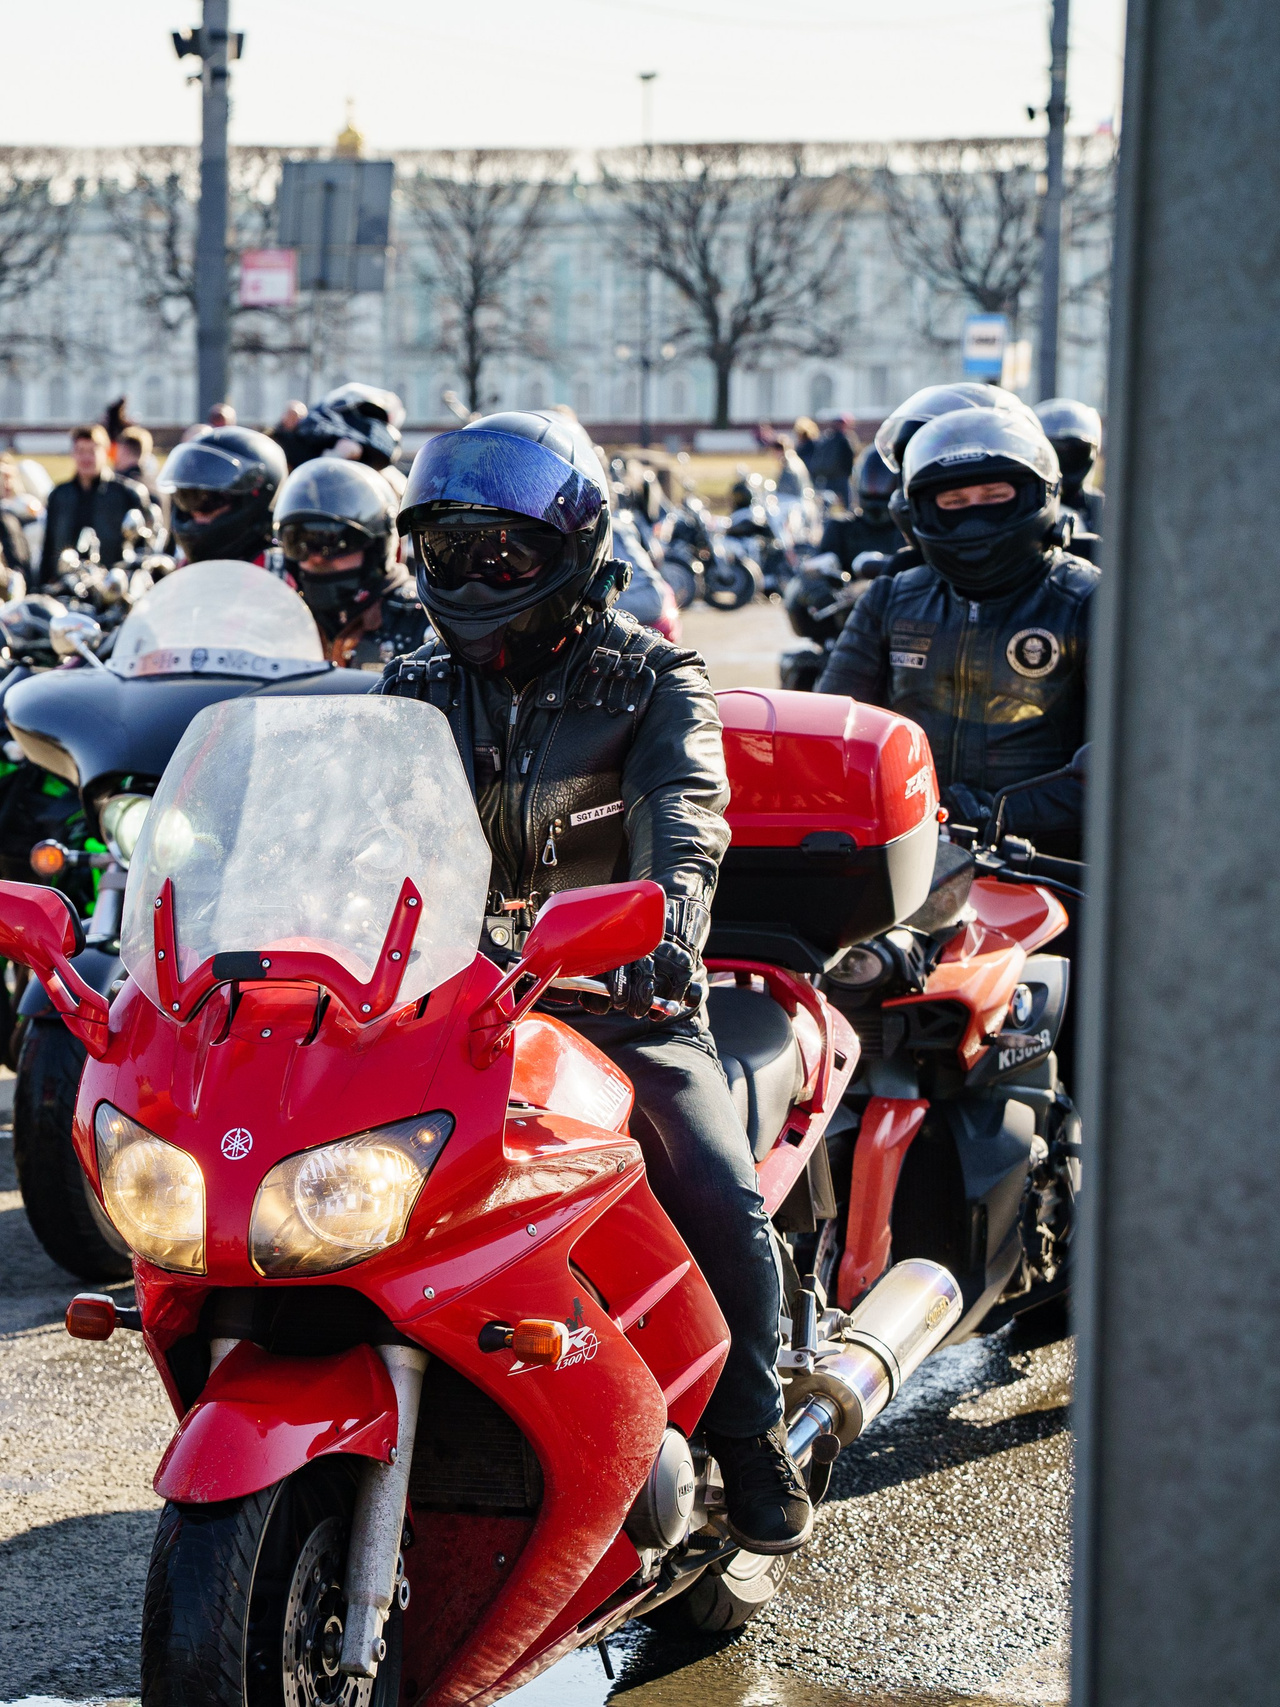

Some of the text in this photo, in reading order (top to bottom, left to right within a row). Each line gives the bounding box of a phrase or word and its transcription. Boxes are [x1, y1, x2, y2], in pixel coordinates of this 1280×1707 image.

[576, 812, 592, 822] SGT
[594, 808, 604, 818] AT
[582, 1073, 631, 1129] YAMAHA
[554, 1353, 583, 1372] 1300
